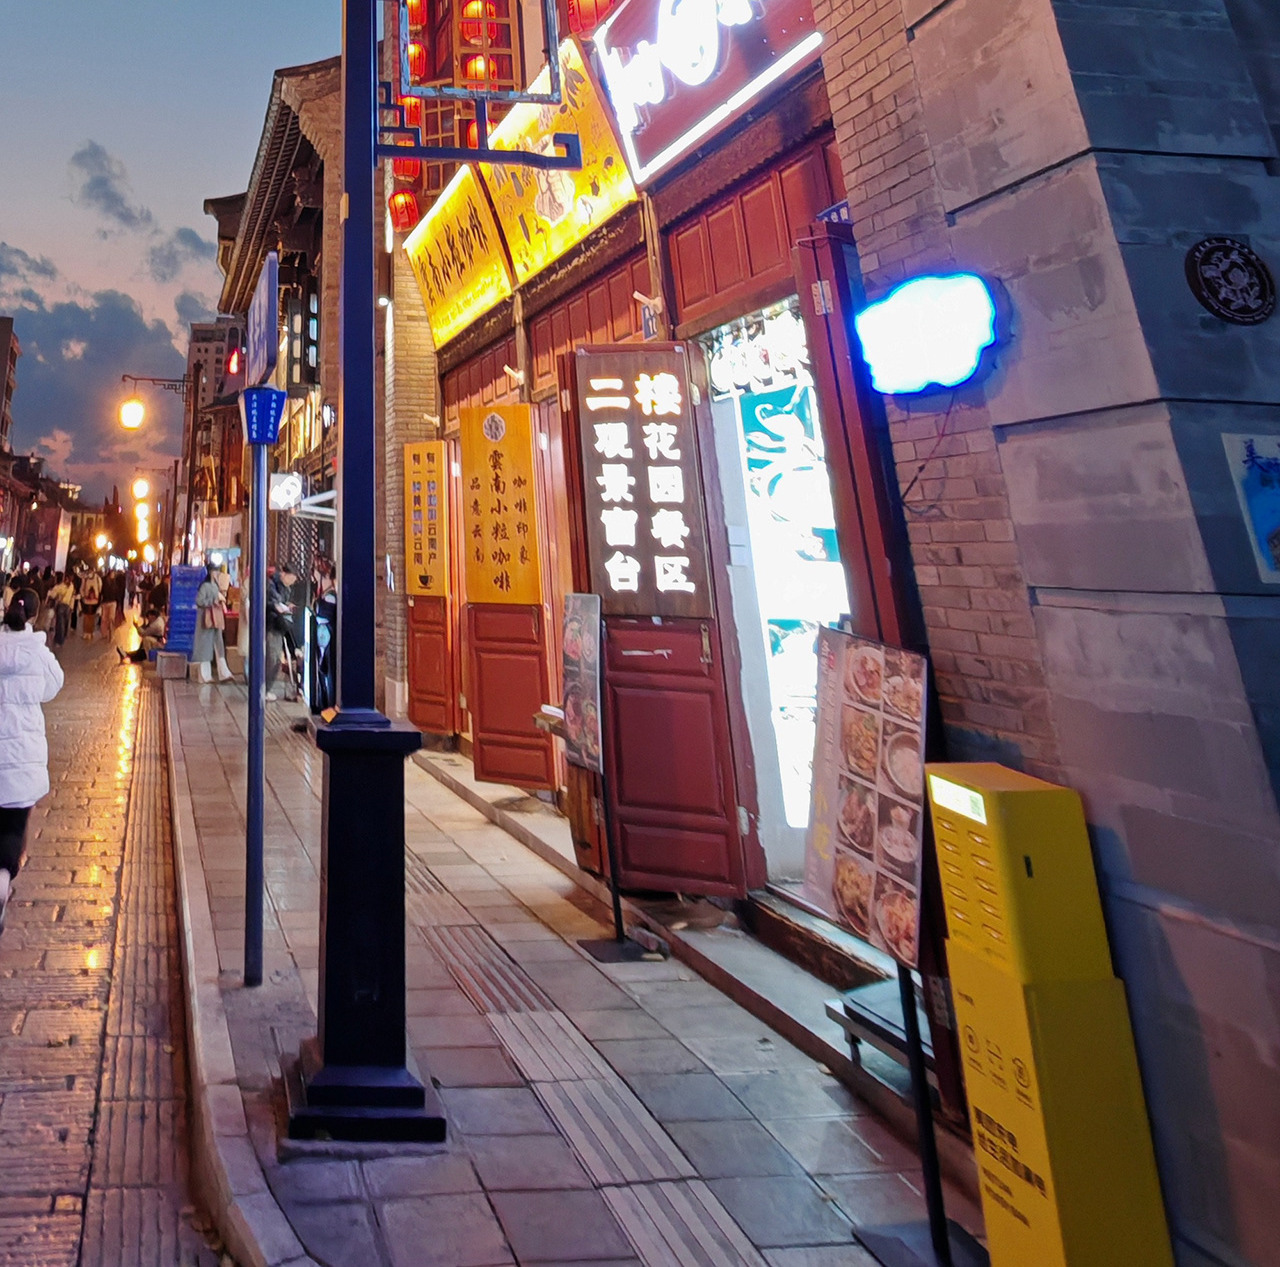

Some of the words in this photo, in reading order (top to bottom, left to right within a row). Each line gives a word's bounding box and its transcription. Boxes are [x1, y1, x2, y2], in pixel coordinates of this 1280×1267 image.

[585, 373, 682, 416] 二楼
[489, 449, 511, 592] 雲南小粒咖啡
